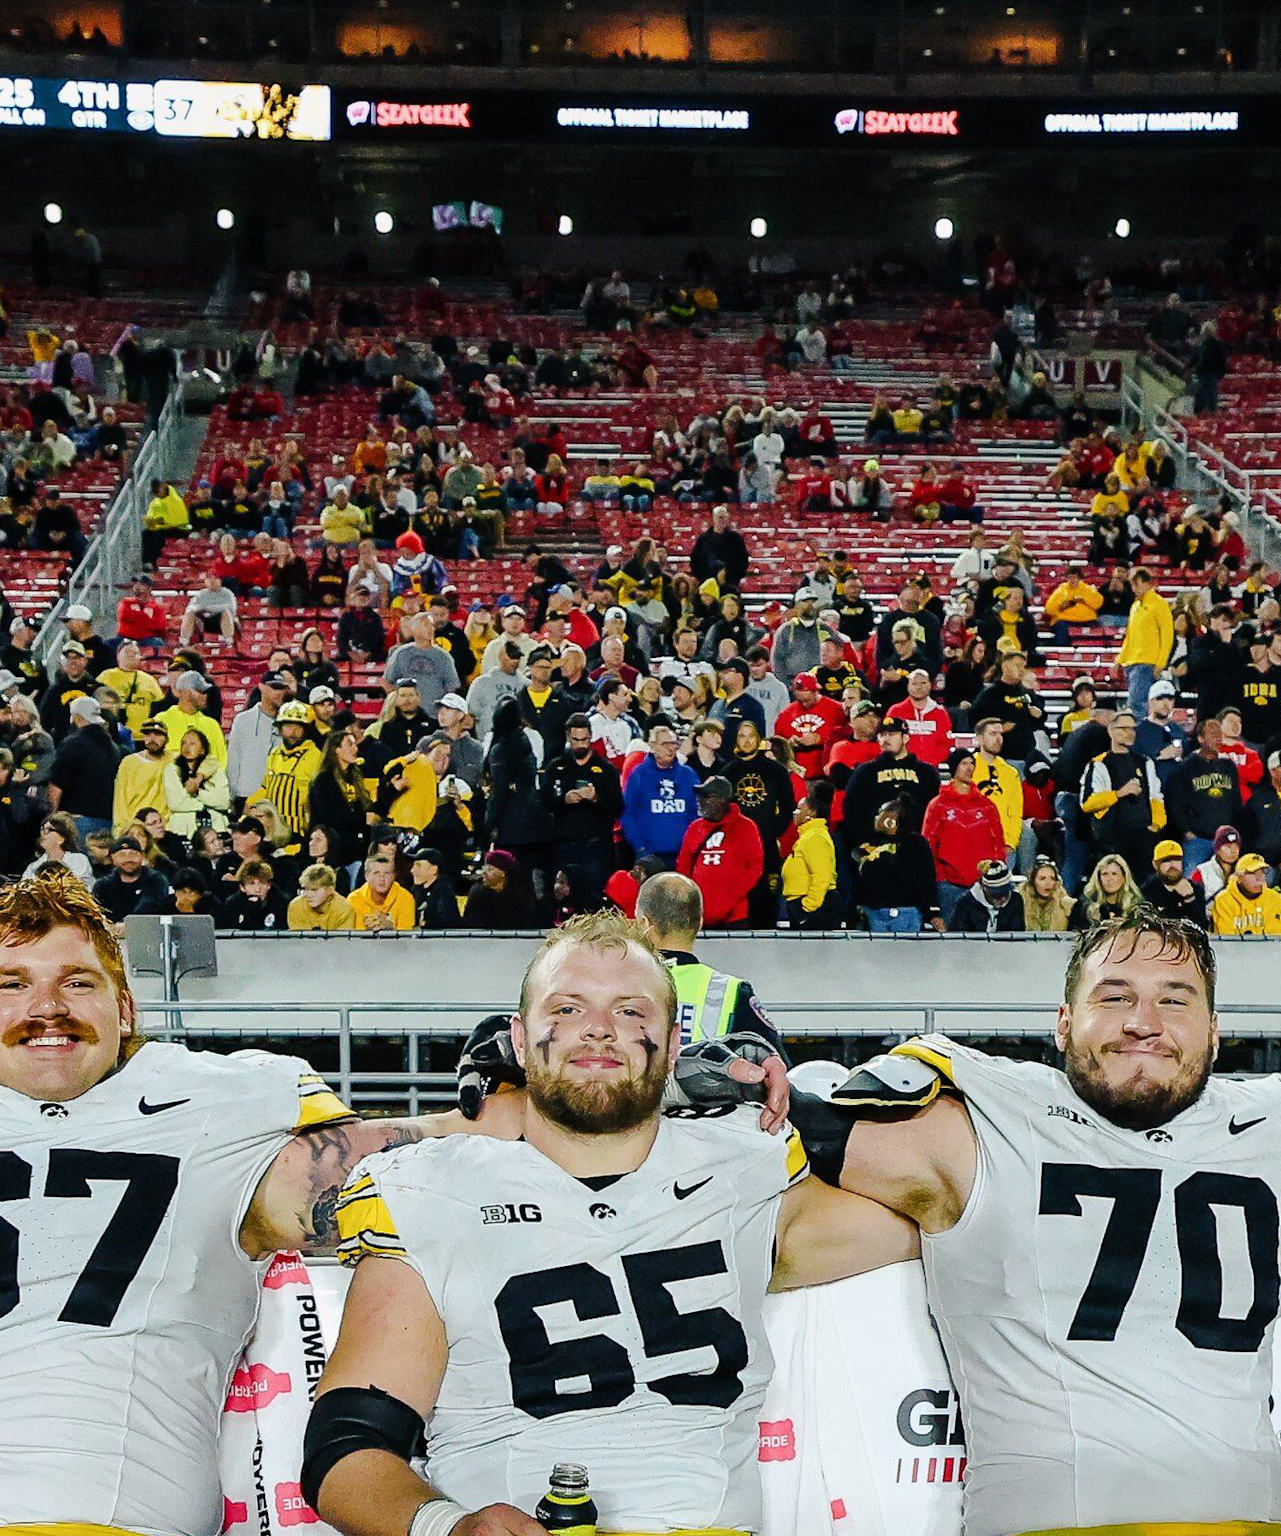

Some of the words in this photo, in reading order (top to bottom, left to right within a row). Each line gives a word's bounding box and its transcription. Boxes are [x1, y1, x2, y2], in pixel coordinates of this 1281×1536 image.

[57, 80, 119, 110] 4TH
[164, 98, 194, 121] 37
[376, 103, 472, 128] SEATGEEK
[864, 110, 959, 135] SEATGEEK
[651, 799, 686, 813] DAD
[1038, 1162, 1280, 1353] 70
[495, 1239, 749, 1420] 65
